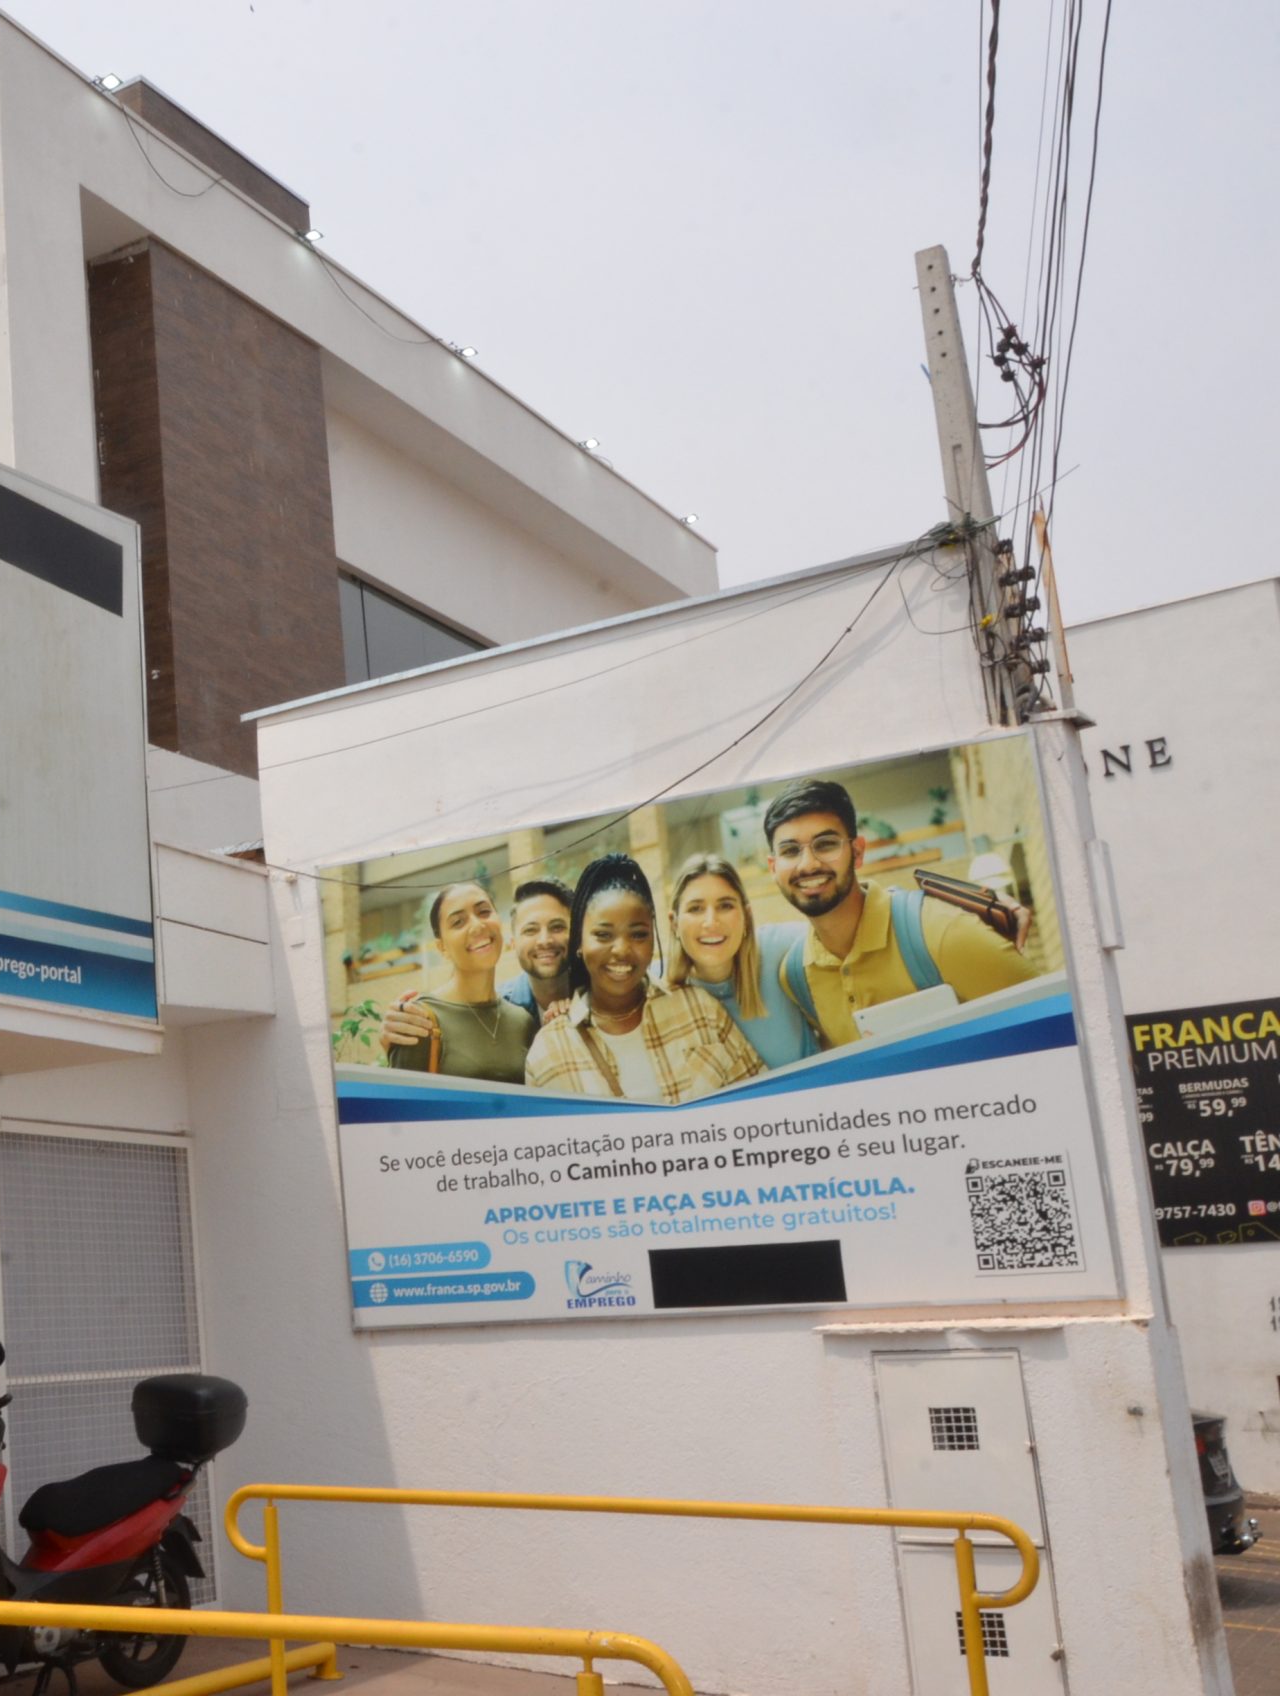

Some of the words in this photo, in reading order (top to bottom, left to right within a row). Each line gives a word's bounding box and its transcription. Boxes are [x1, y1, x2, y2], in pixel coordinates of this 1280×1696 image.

[1132, 1010, 1280, 1052] FRANCA
[1147, 1039, 1278, 1072] PREMIUM
[1178, 1077, 1250, 1094] BERMUDAS
[379, 1154, 401, 1173] Se
[404, 1147, 447, 1171] você
[451, 1146, 509, 1173] deseja
[513, 1133, 626, 1165] capacitação
[631, 1130, 674, 1155] para
[680, 1124, 727, 1145] mais
[733, 1109, 892, 1143] oportunidades
[898, 1106, 927, 1125] no
[933, 1094, 1038, 1123] mercado
[436, 1174, 459, 1193] de
[464, 1168, 545, 1190] trabalho,
[550, 1168, 562, 1183] o
[567, 1152, 658, 1182] Caminho
[663, 1154, 709, 1178] para
[714, 1155, 727, 1170] o
[732, 1145, 831, 1171] Emprego
[837, 1136, 851, 1158] é
[856, 1139, 896, 1158] seu
[902, 1132, 967, 1157] lugar.
[981, 1154, 1063, 1170] ESCANEIE-ME
[1148, 1138, 1216, 1160] CALÇA
[484, 1199, 607, 1225] APROVEITE
[614, 1198, 627, 1215] E
[632, 1192, 696, 1217] FAÇA
[702, 1189, 752, 1210] SUA
[757, 1175, 917, 1205] MATRÍCULA.
[502, 1228, 530, 1245] Os
[535, 1225, 603, 1244] cursos
[607, 1218, 644, 1239] são
[650, 1207, 775, 1236] totalmente
[781, 1201, 898, 1232] gratuitos!
[387, 1250, 412, 1268] (16)
[413, 1248, 479, 1267] 3706-6590
[392, 1277, 522, 1299] www.franca.sp.gov.br
[566, 1295, 637, 1310] EMPREGO
